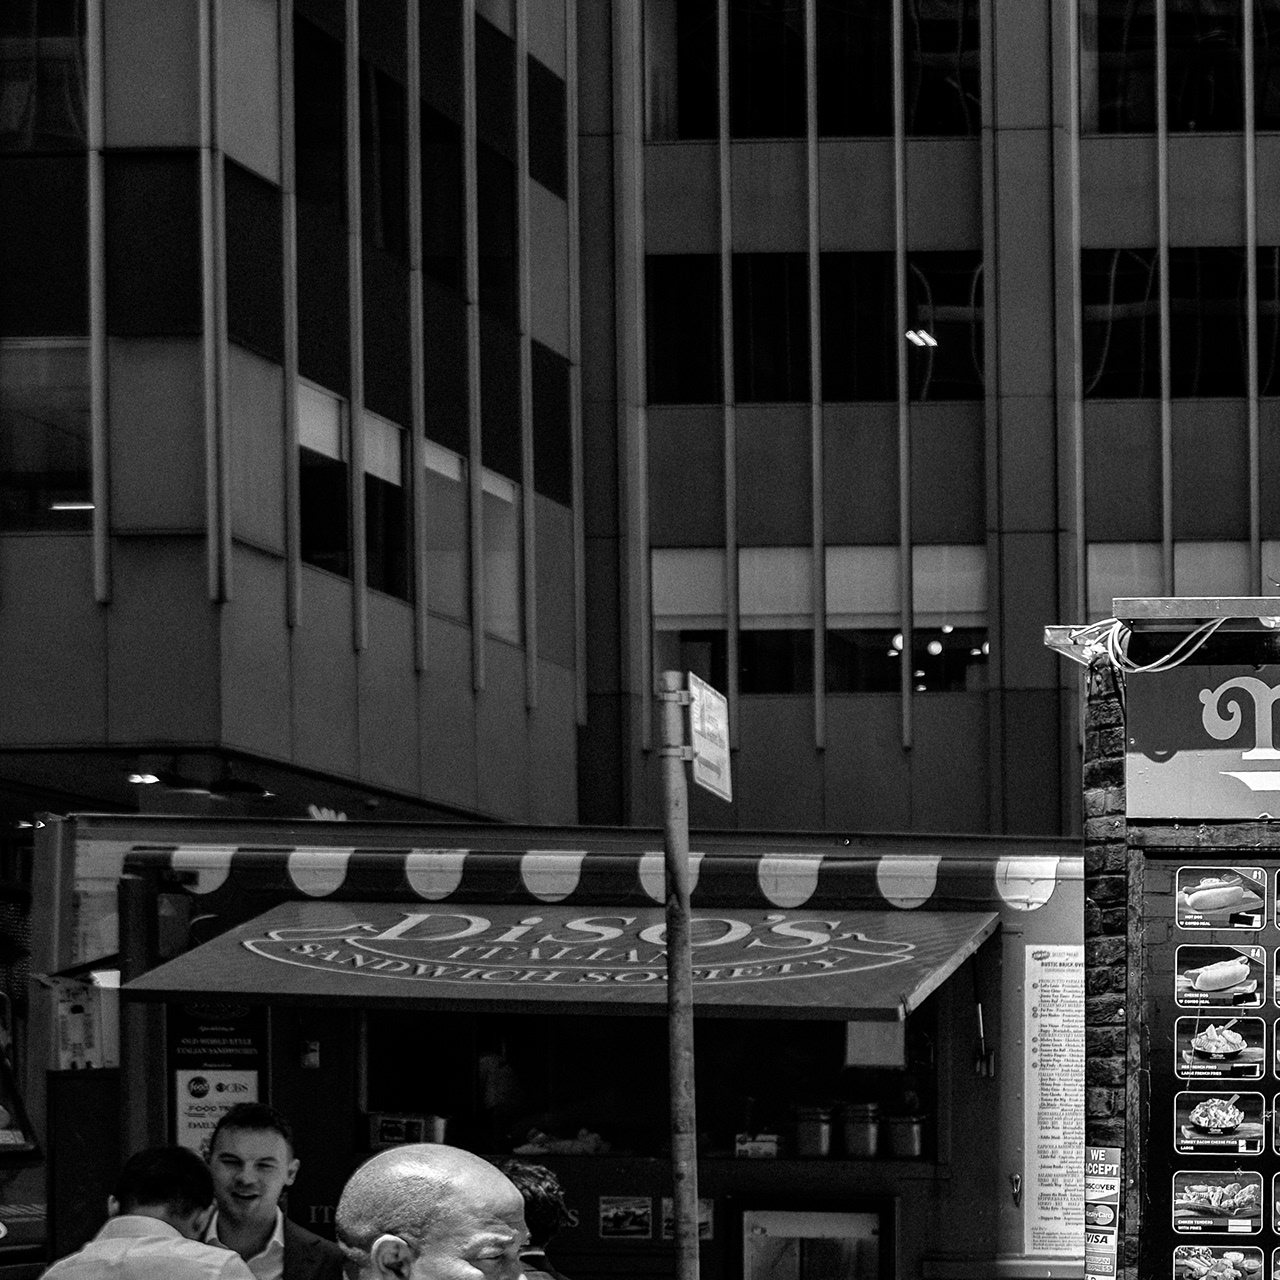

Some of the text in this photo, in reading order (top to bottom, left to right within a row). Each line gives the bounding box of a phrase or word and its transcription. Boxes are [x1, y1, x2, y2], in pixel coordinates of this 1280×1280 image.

[290, 941, 560, 982] SANDWICH
[1090, 1149, 1106, 1161] WE
[1086, 1162, 1119, 1176] CCEPT
[1086, 1233, 1108, 1244] VISA
